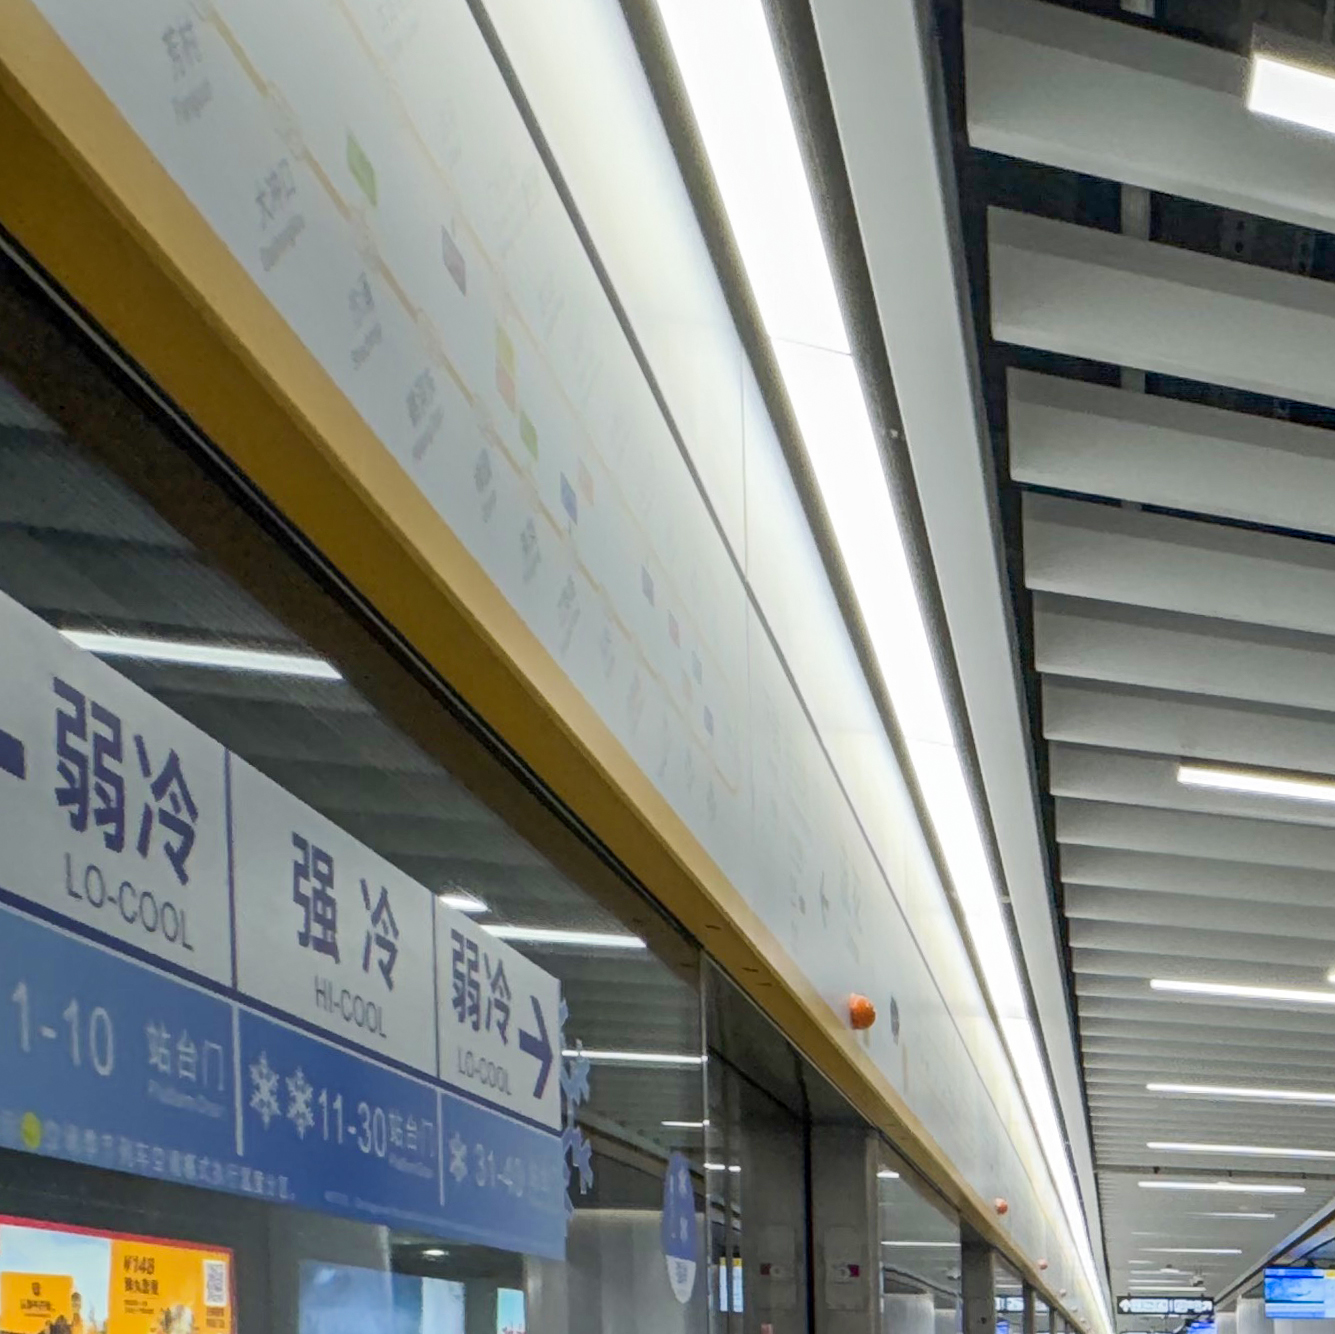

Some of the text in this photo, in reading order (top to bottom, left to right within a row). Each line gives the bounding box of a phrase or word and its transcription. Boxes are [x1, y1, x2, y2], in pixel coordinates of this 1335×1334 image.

[53, 677, 198, 885] 弱冷
[65, 852, 194, 951] LO-COOL
[292, 831, 399, 991] 强冷
[12, 981, 114, 1076] 1-10
[315, 975, 387, 1039] HI-COOL
[451, 928, 511, 1045] 弱冷
[458, 1047, 512, 1096] LO-COOL
[319, 1087, 386, 1158] 11-30
